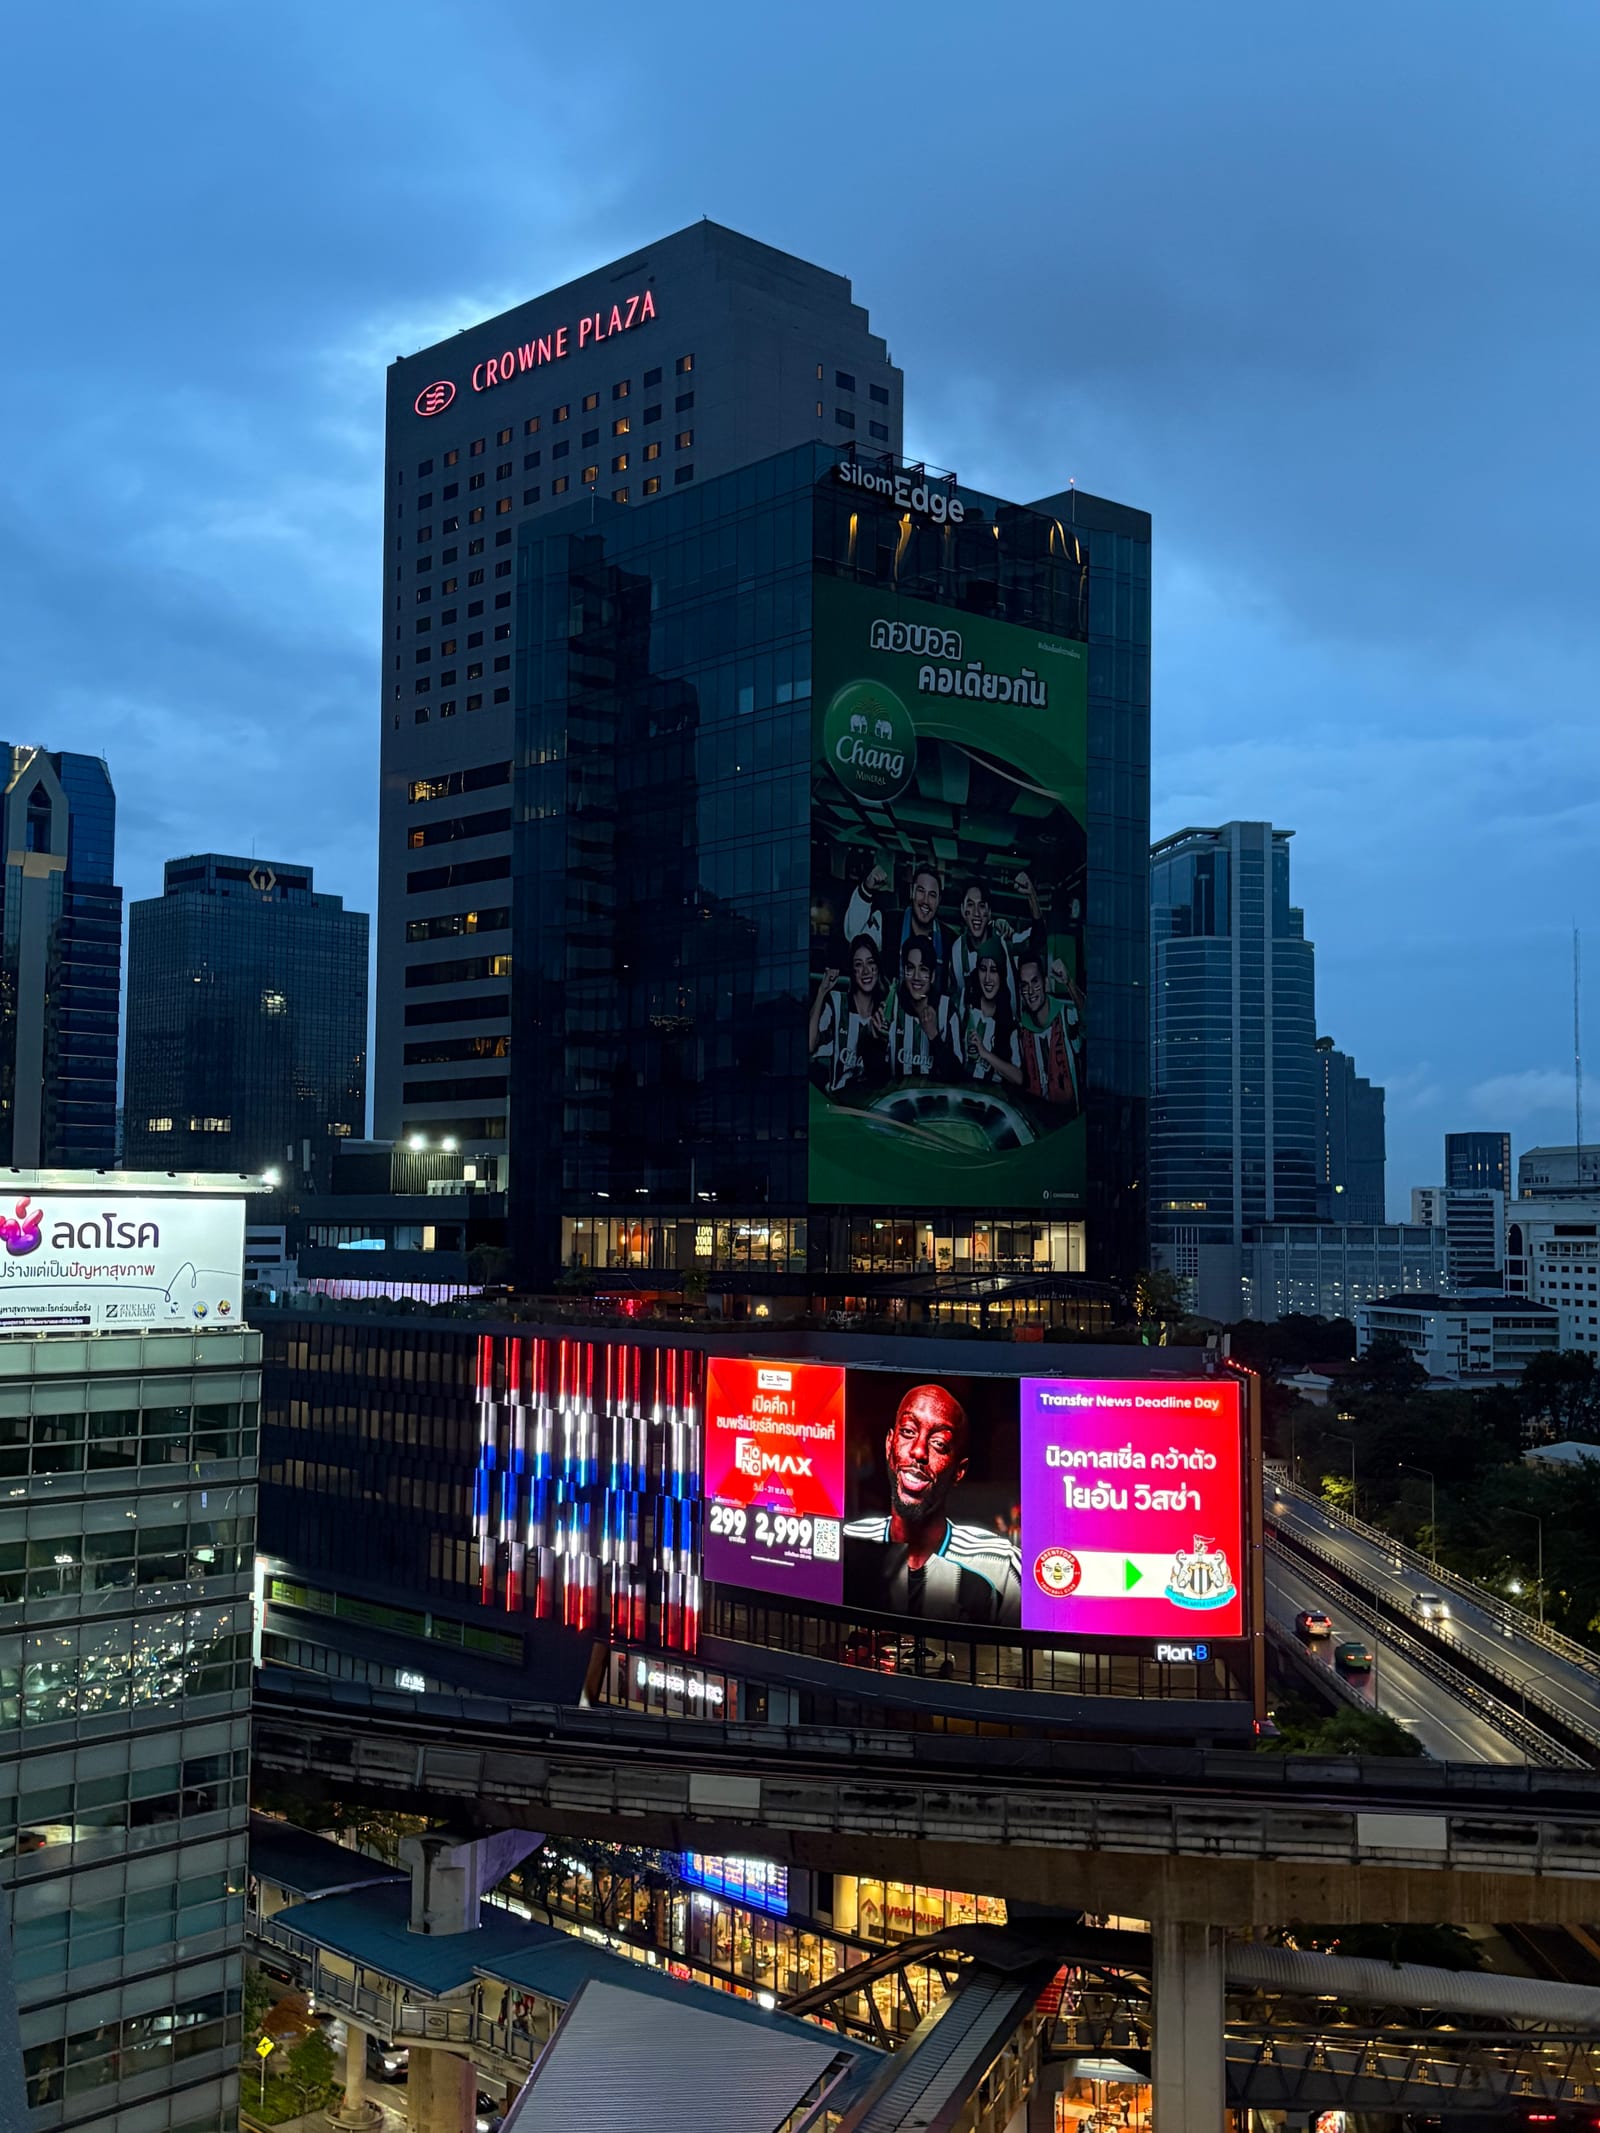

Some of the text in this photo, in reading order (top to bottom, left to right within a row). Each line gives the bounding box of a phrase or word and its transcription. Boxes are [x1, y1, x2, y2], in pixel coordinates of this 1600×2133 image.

[471, 290, 657, 394] CROWNE PLAZA
[869, 619, 962, 661] คอบอล
[917, 660, 1048, 707] คอเดียวกัน
[834, 735, 905, 779] Chang
[51, 1212, 160, 1250] ลดโรค
[752, 1395, 788, 1416] เปิดศึก
[1040, 1393, 1220, 1411] Transfer News Deadline Day
[1151, 1446, 1217, 1471] คว้าตัว
[1062, 1476, 1128, 1511] โยอัน
[710, 1505, 813, 1547] 299 2,999
